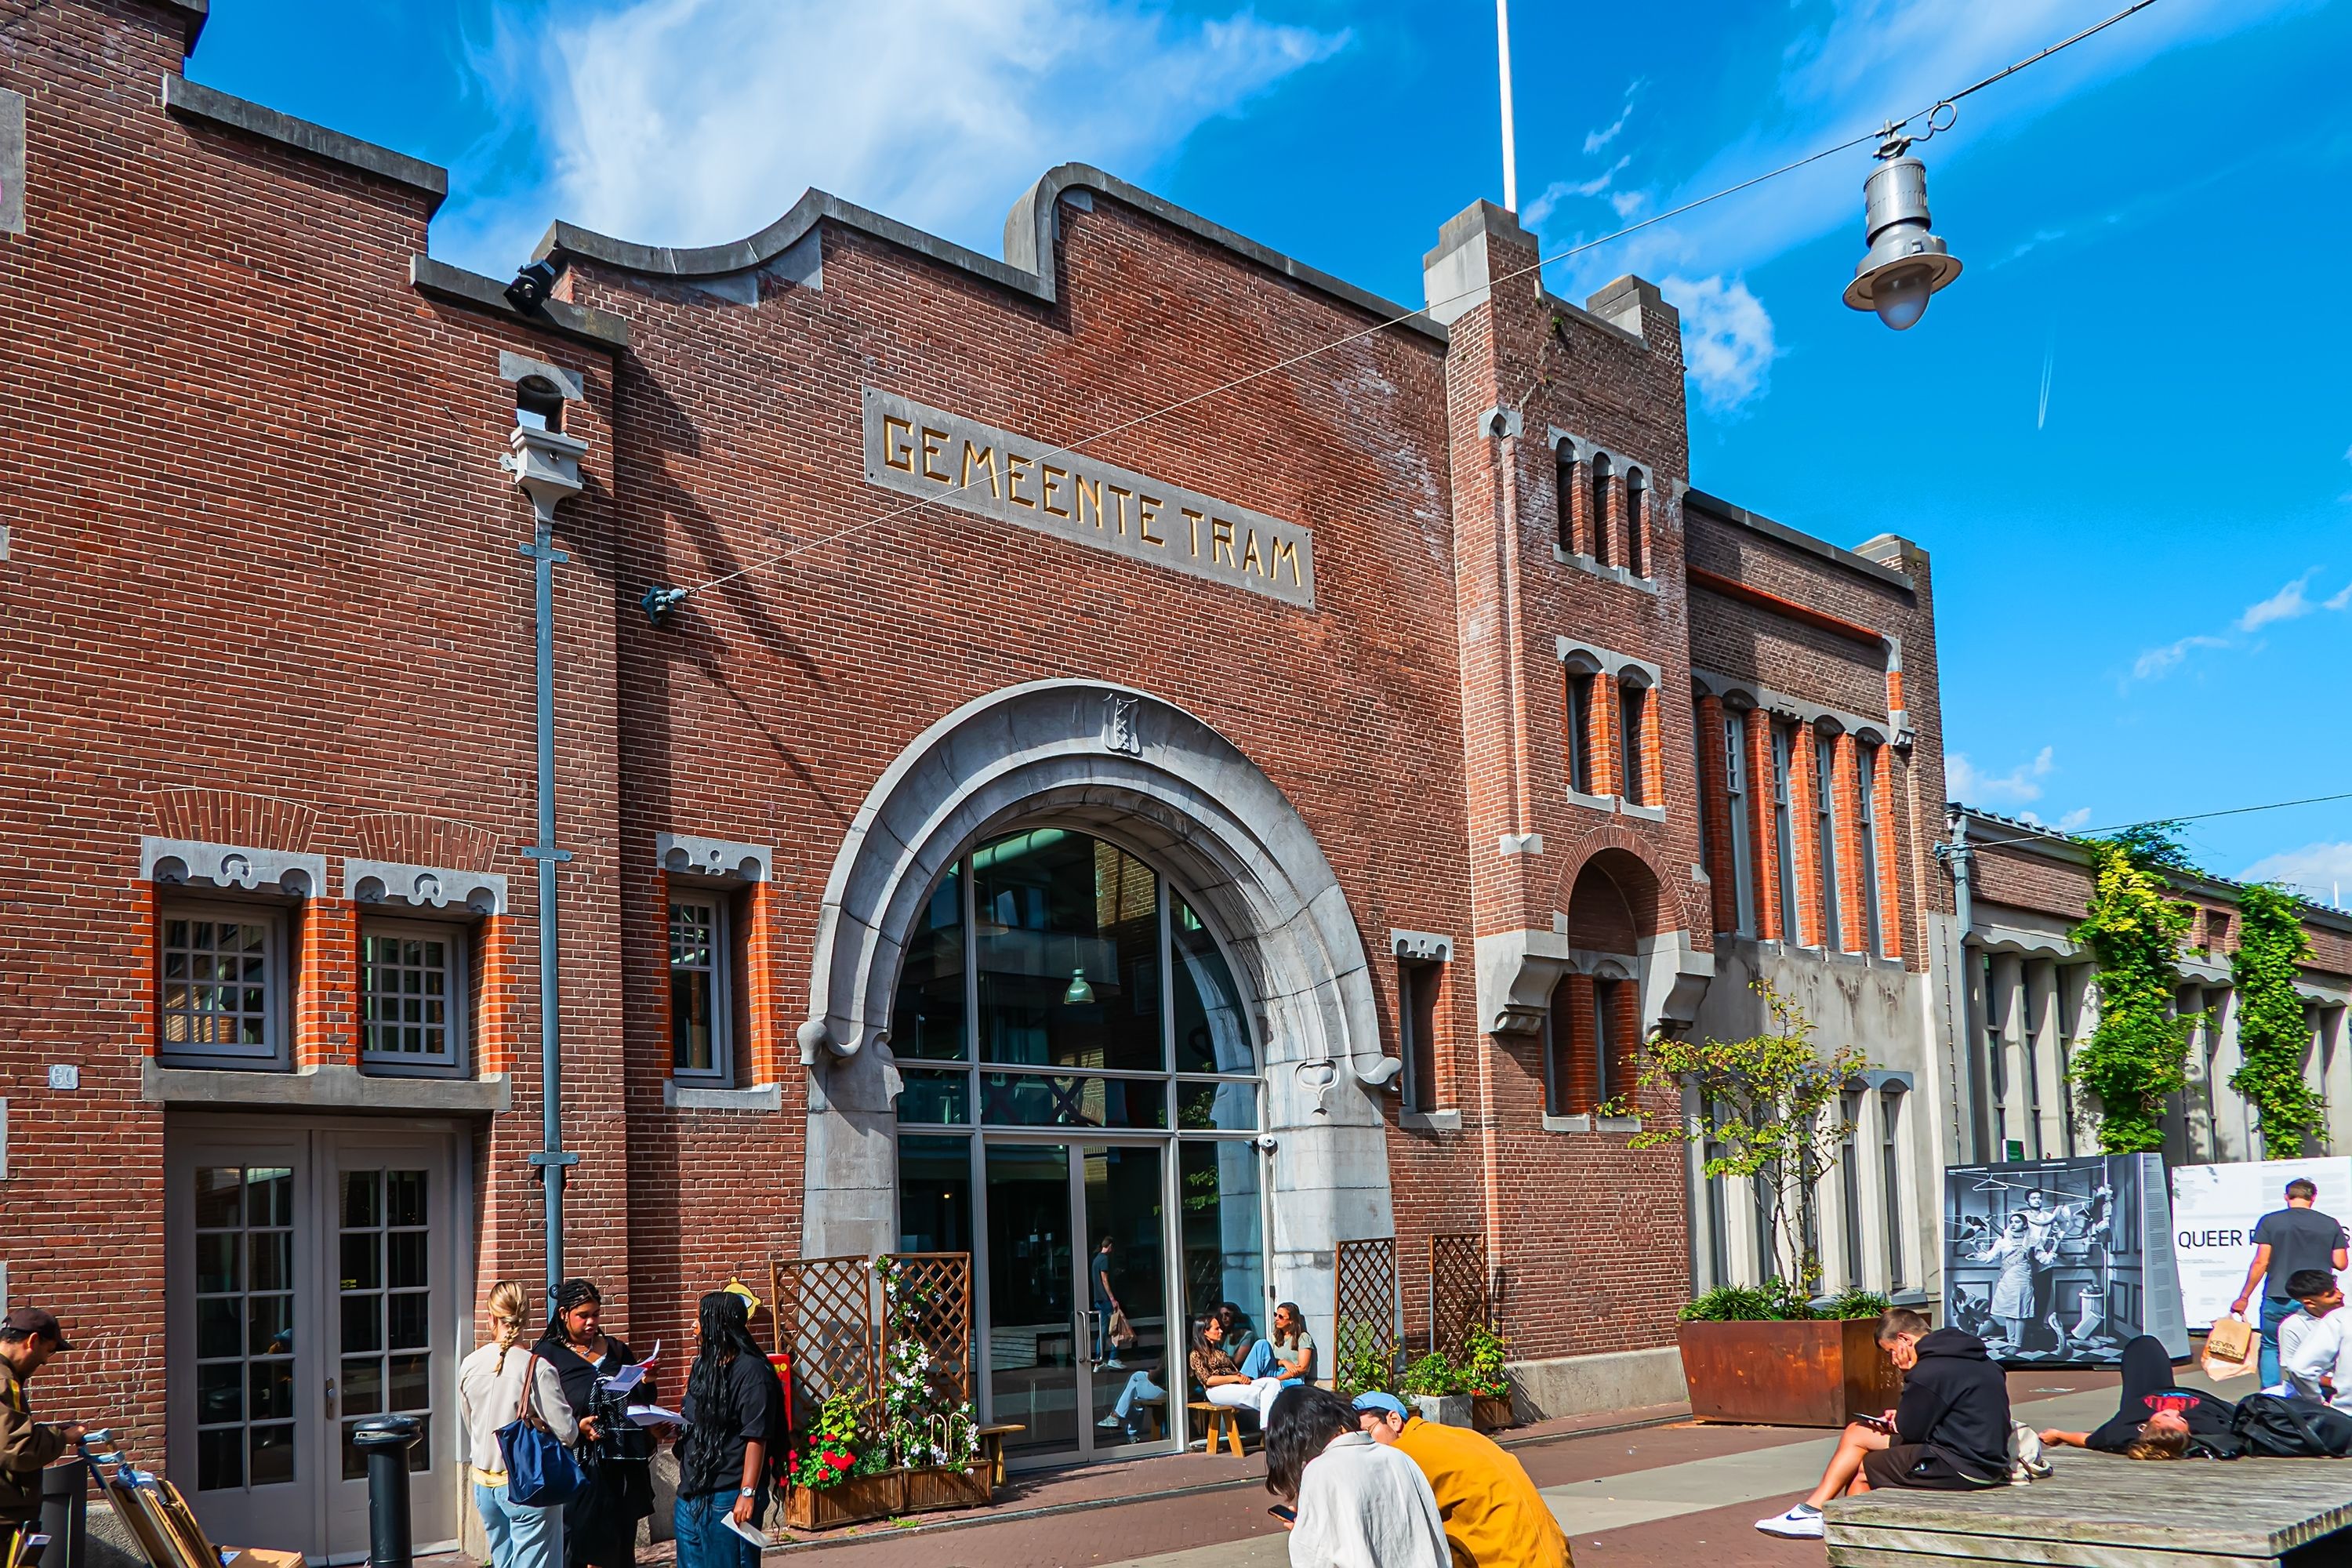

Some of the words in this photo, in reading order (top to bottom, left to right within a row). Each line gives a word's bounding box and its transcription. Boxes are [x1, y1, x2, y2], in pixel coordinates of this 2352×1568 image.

[884, 414, 1165, 547] GEMEENTE
[1181, 507, 1301, 587] TRAM
[51, 1067, 76, 1085] 60
[2179, 1229, 2242, 1249] QUEER
